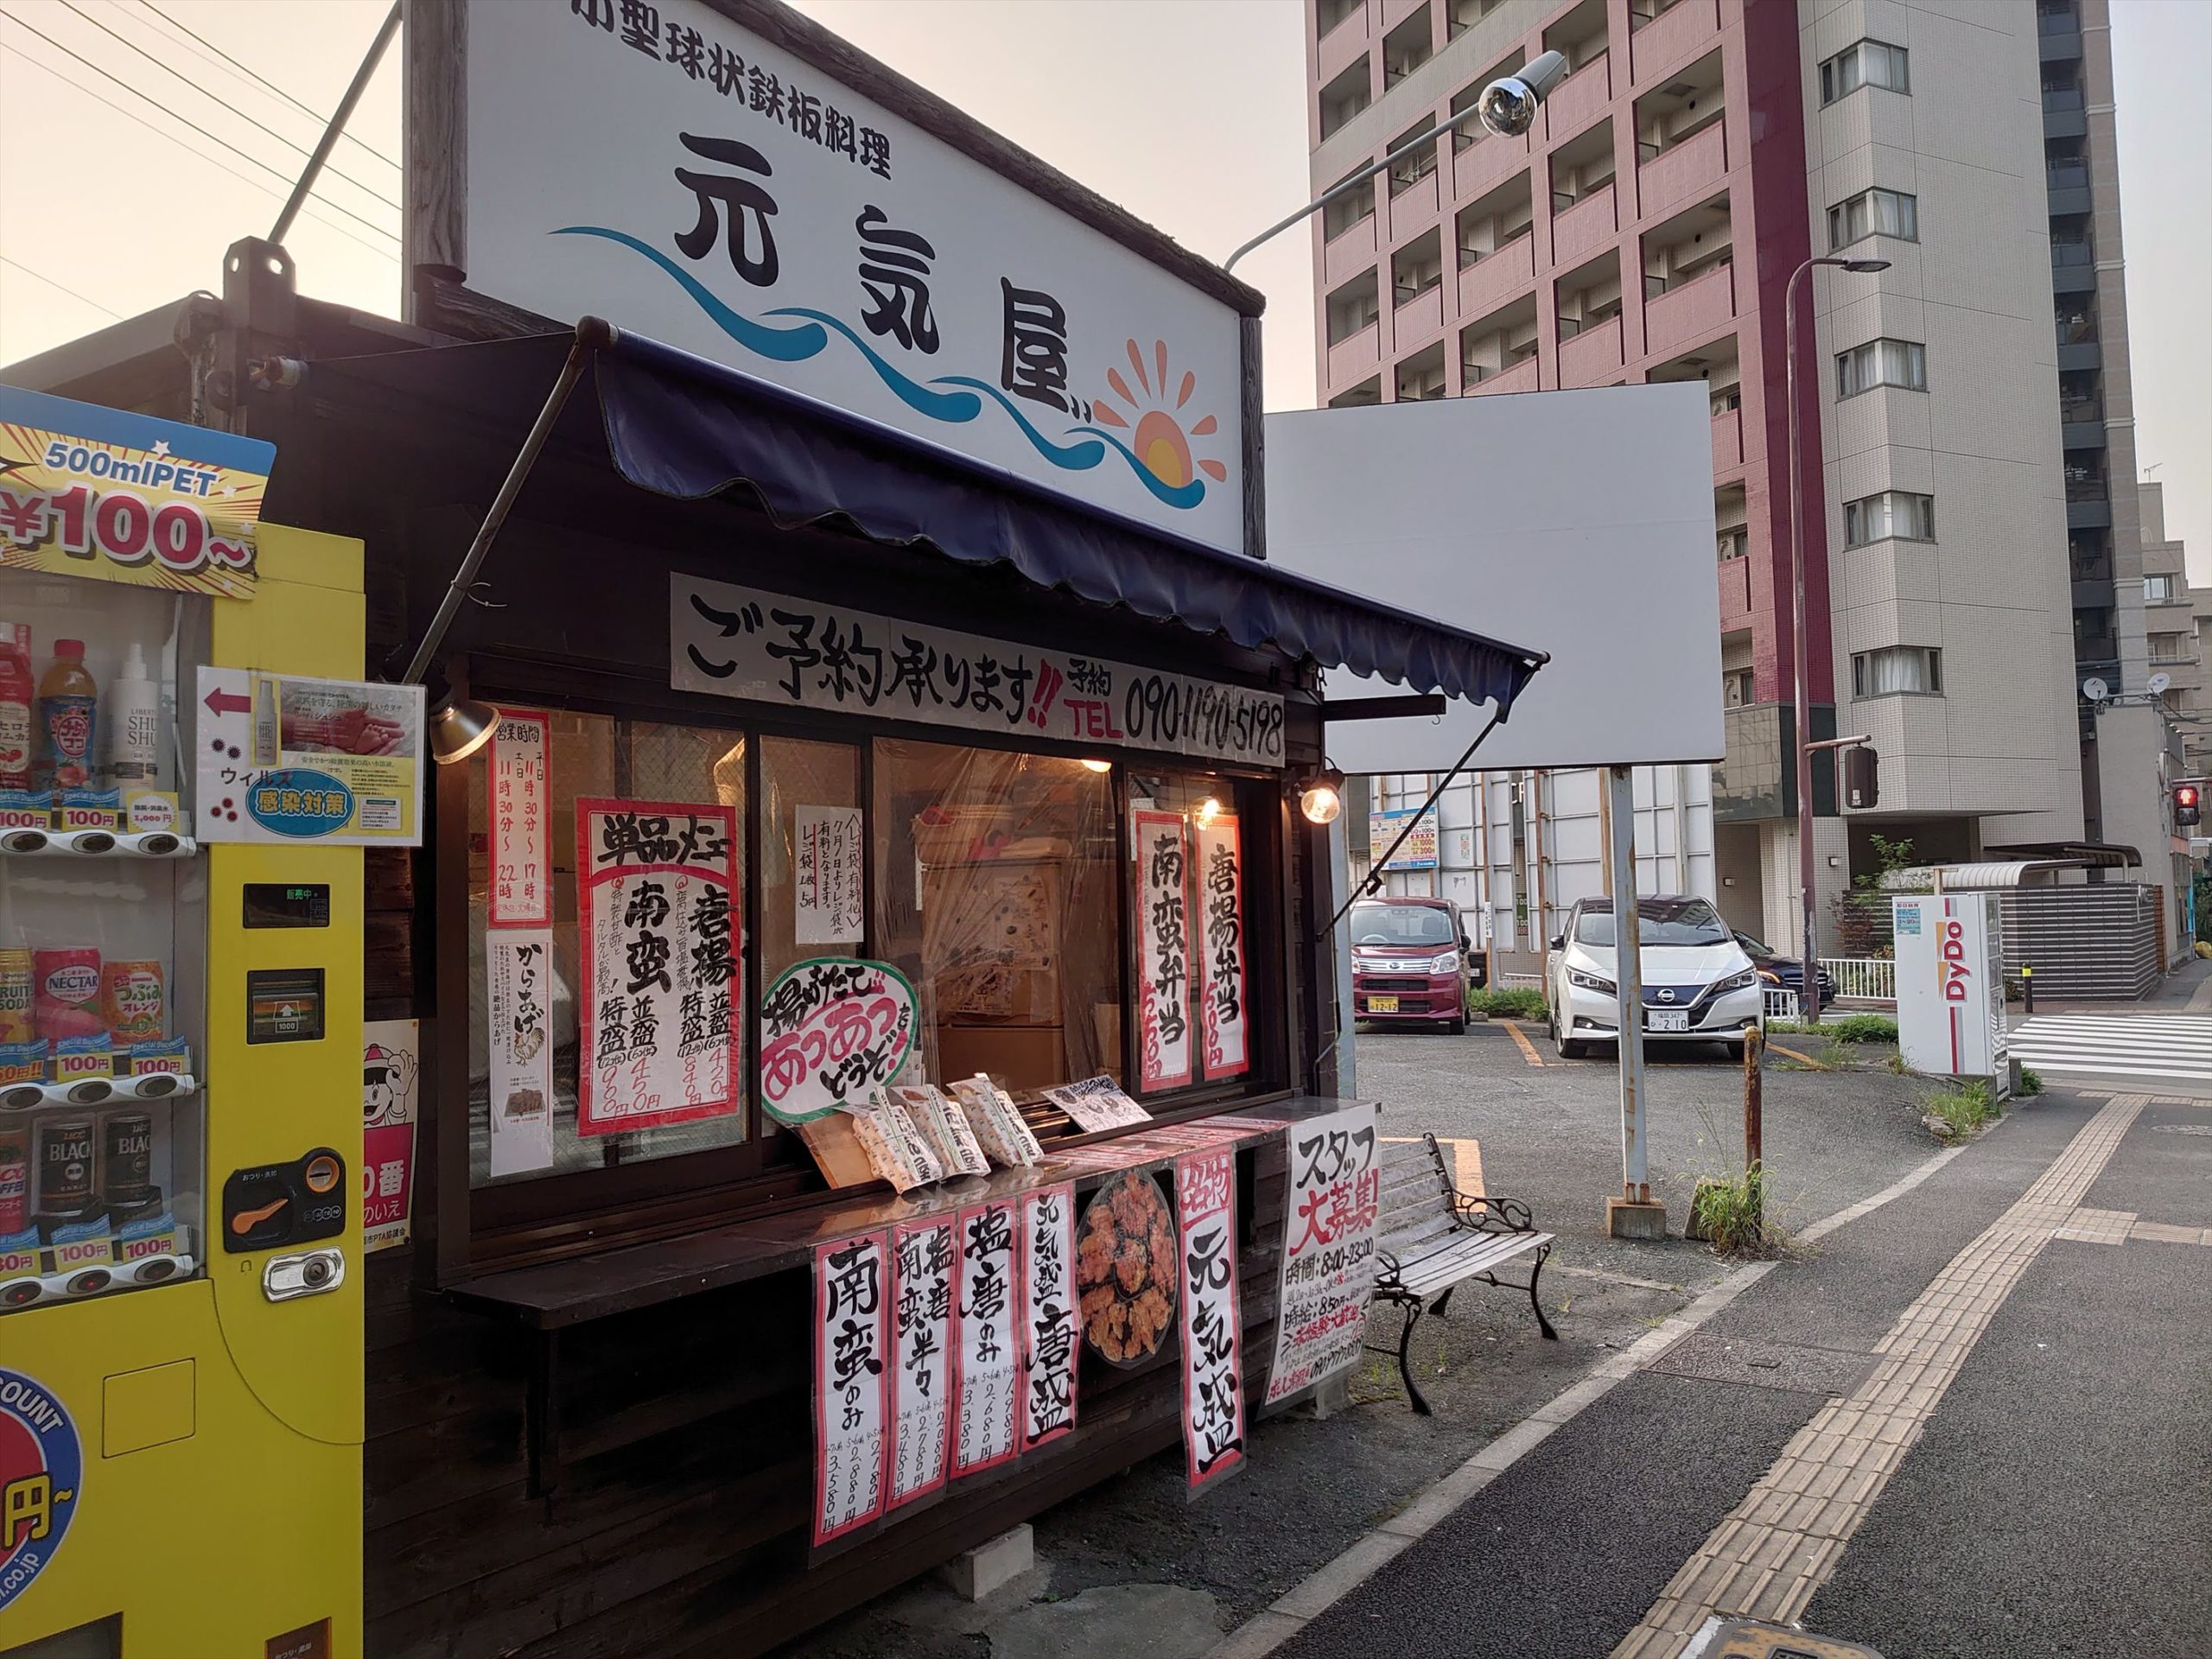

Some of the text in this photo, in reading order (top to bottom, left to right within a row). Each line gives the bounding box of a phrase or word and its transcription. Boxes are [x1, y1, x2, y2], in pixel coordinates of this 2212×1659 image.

[1065, 658, 1112, 692] 予約
[496, 722, 540, 742] 営業時間
[1064, 697, 1122, 738] TEL
[67, 810, 114, 826] 100円
[257, 789, 346, 816] 感染対策
[1152, 833, 1186, 1046] 南蛮弁当
[1943, 920, 1972, 1002] DyDo
[48, 976, 99, 989] NECTAR
[514, 943, 545, 1035] からあげ
[61, 1056, 109, 1071] 100円
[135, 1059, 180, 1074] 100円
[1296, 1125, 1376, 1189] スタッフ
[1288, 1168, 1378, 1257] 大募集
[60, 1243, 108, 1262] 100円
[125, 1239, 172, 1259] 100円
[826, 1237, 883, 1431] 南蛮のみ
[1187, 1225, 1243, 1474] 元気盛
